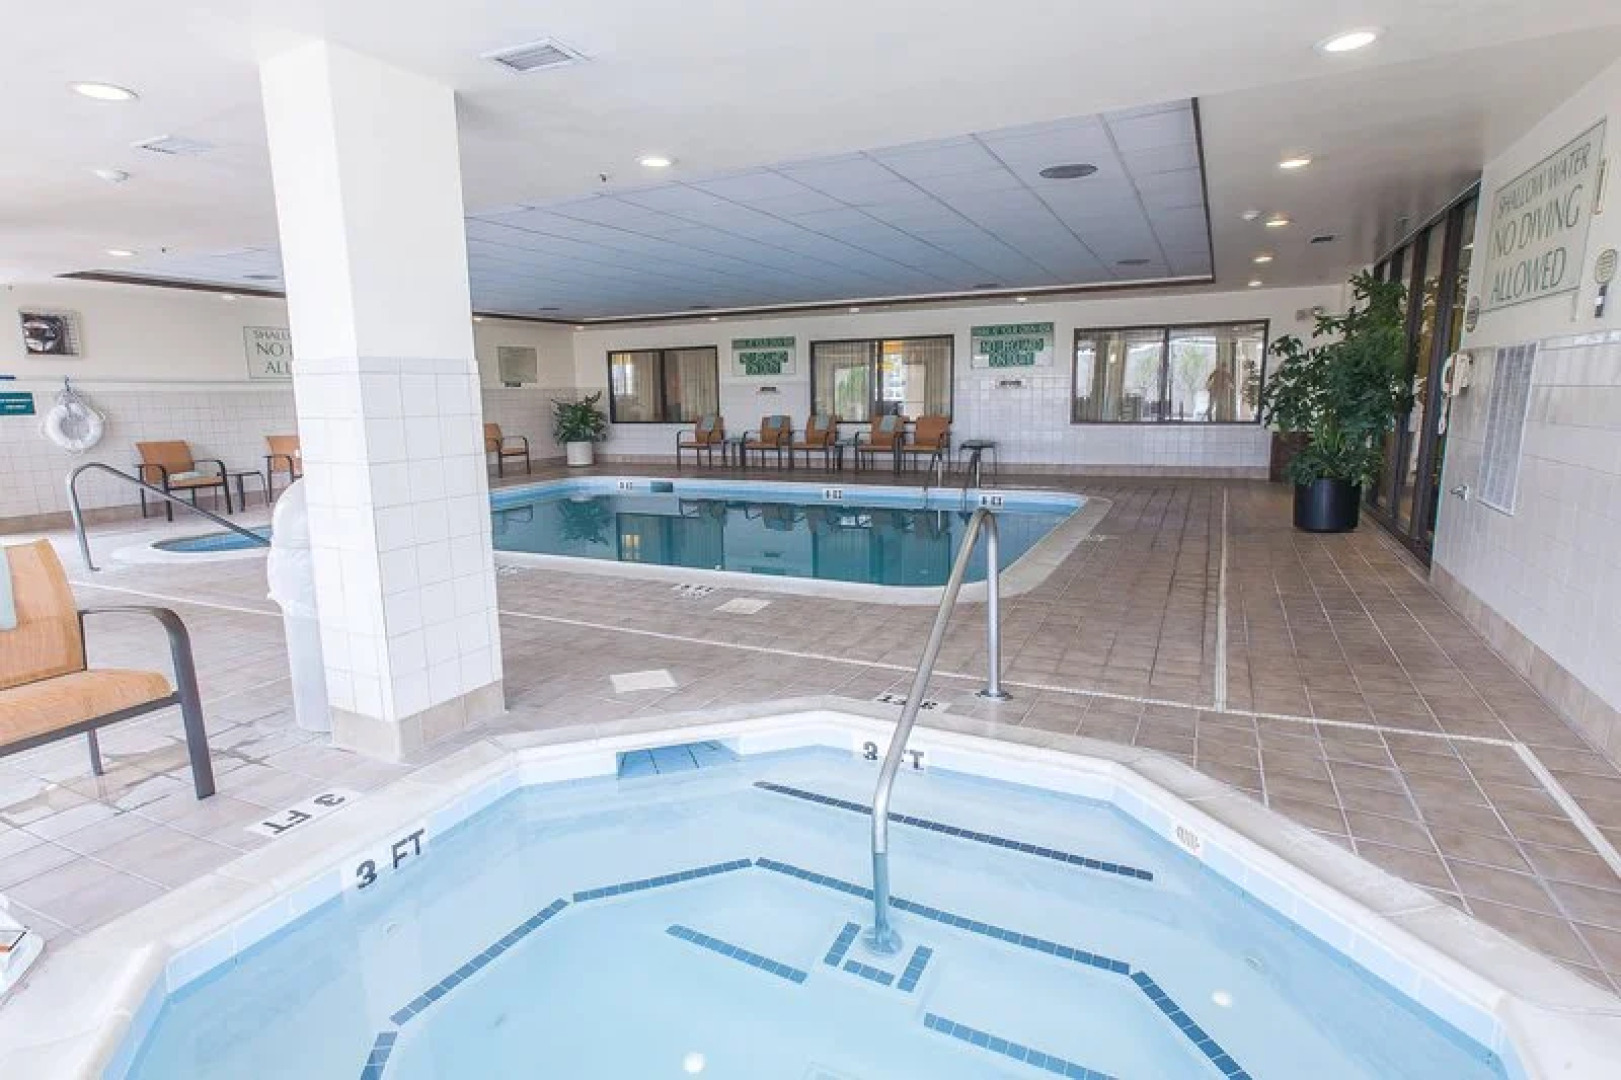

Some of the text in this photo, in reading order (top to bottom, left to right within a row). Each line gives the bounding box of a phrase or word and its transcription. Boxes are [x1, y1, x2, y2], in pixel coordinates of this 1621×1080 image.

[1491, 184, 1583, 260] NO DIVING
[1489, 247, 1566, 304] ALLOWED
[256, 342, 284, 357] NO
[863, 741, 878, 760] 3
[263, 793, 346, 834] 3 FT
[356, 828, 425, 889] 3 FT
